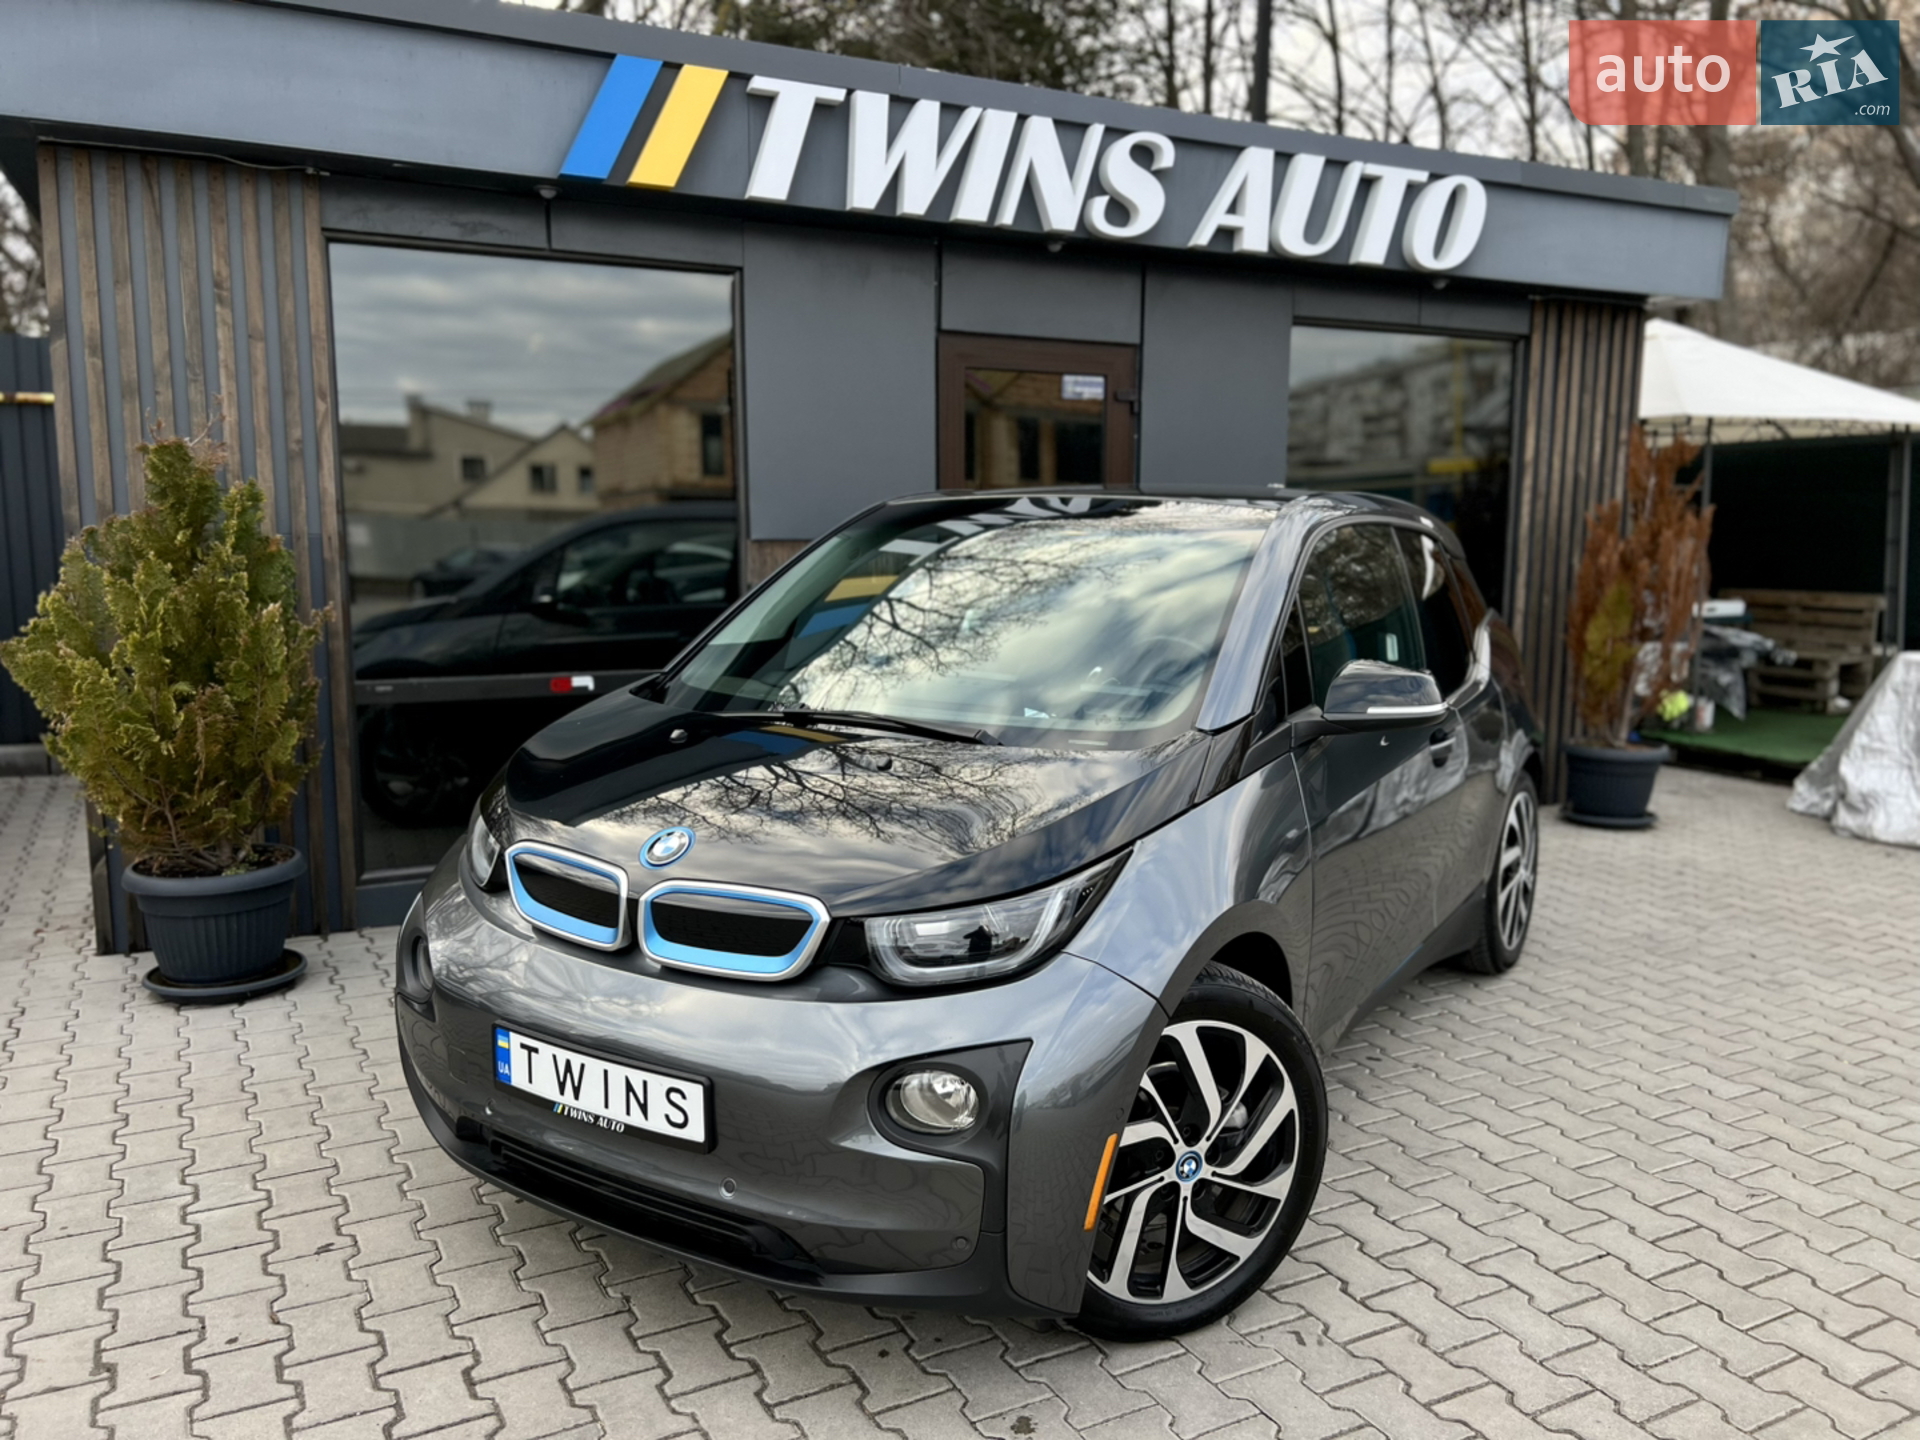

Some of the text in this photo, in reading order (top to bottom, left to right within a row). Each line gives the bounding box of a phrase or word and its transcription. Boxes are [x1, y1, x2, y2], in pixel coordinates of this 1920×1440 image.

[746, 75, 1489, 272] TWINS AUTO
[498, 1060, 510, 1076] UA
[519, 1042, 689, 1130] TWINS
[563, 1105, 625, 1133] TWINS AUTO
